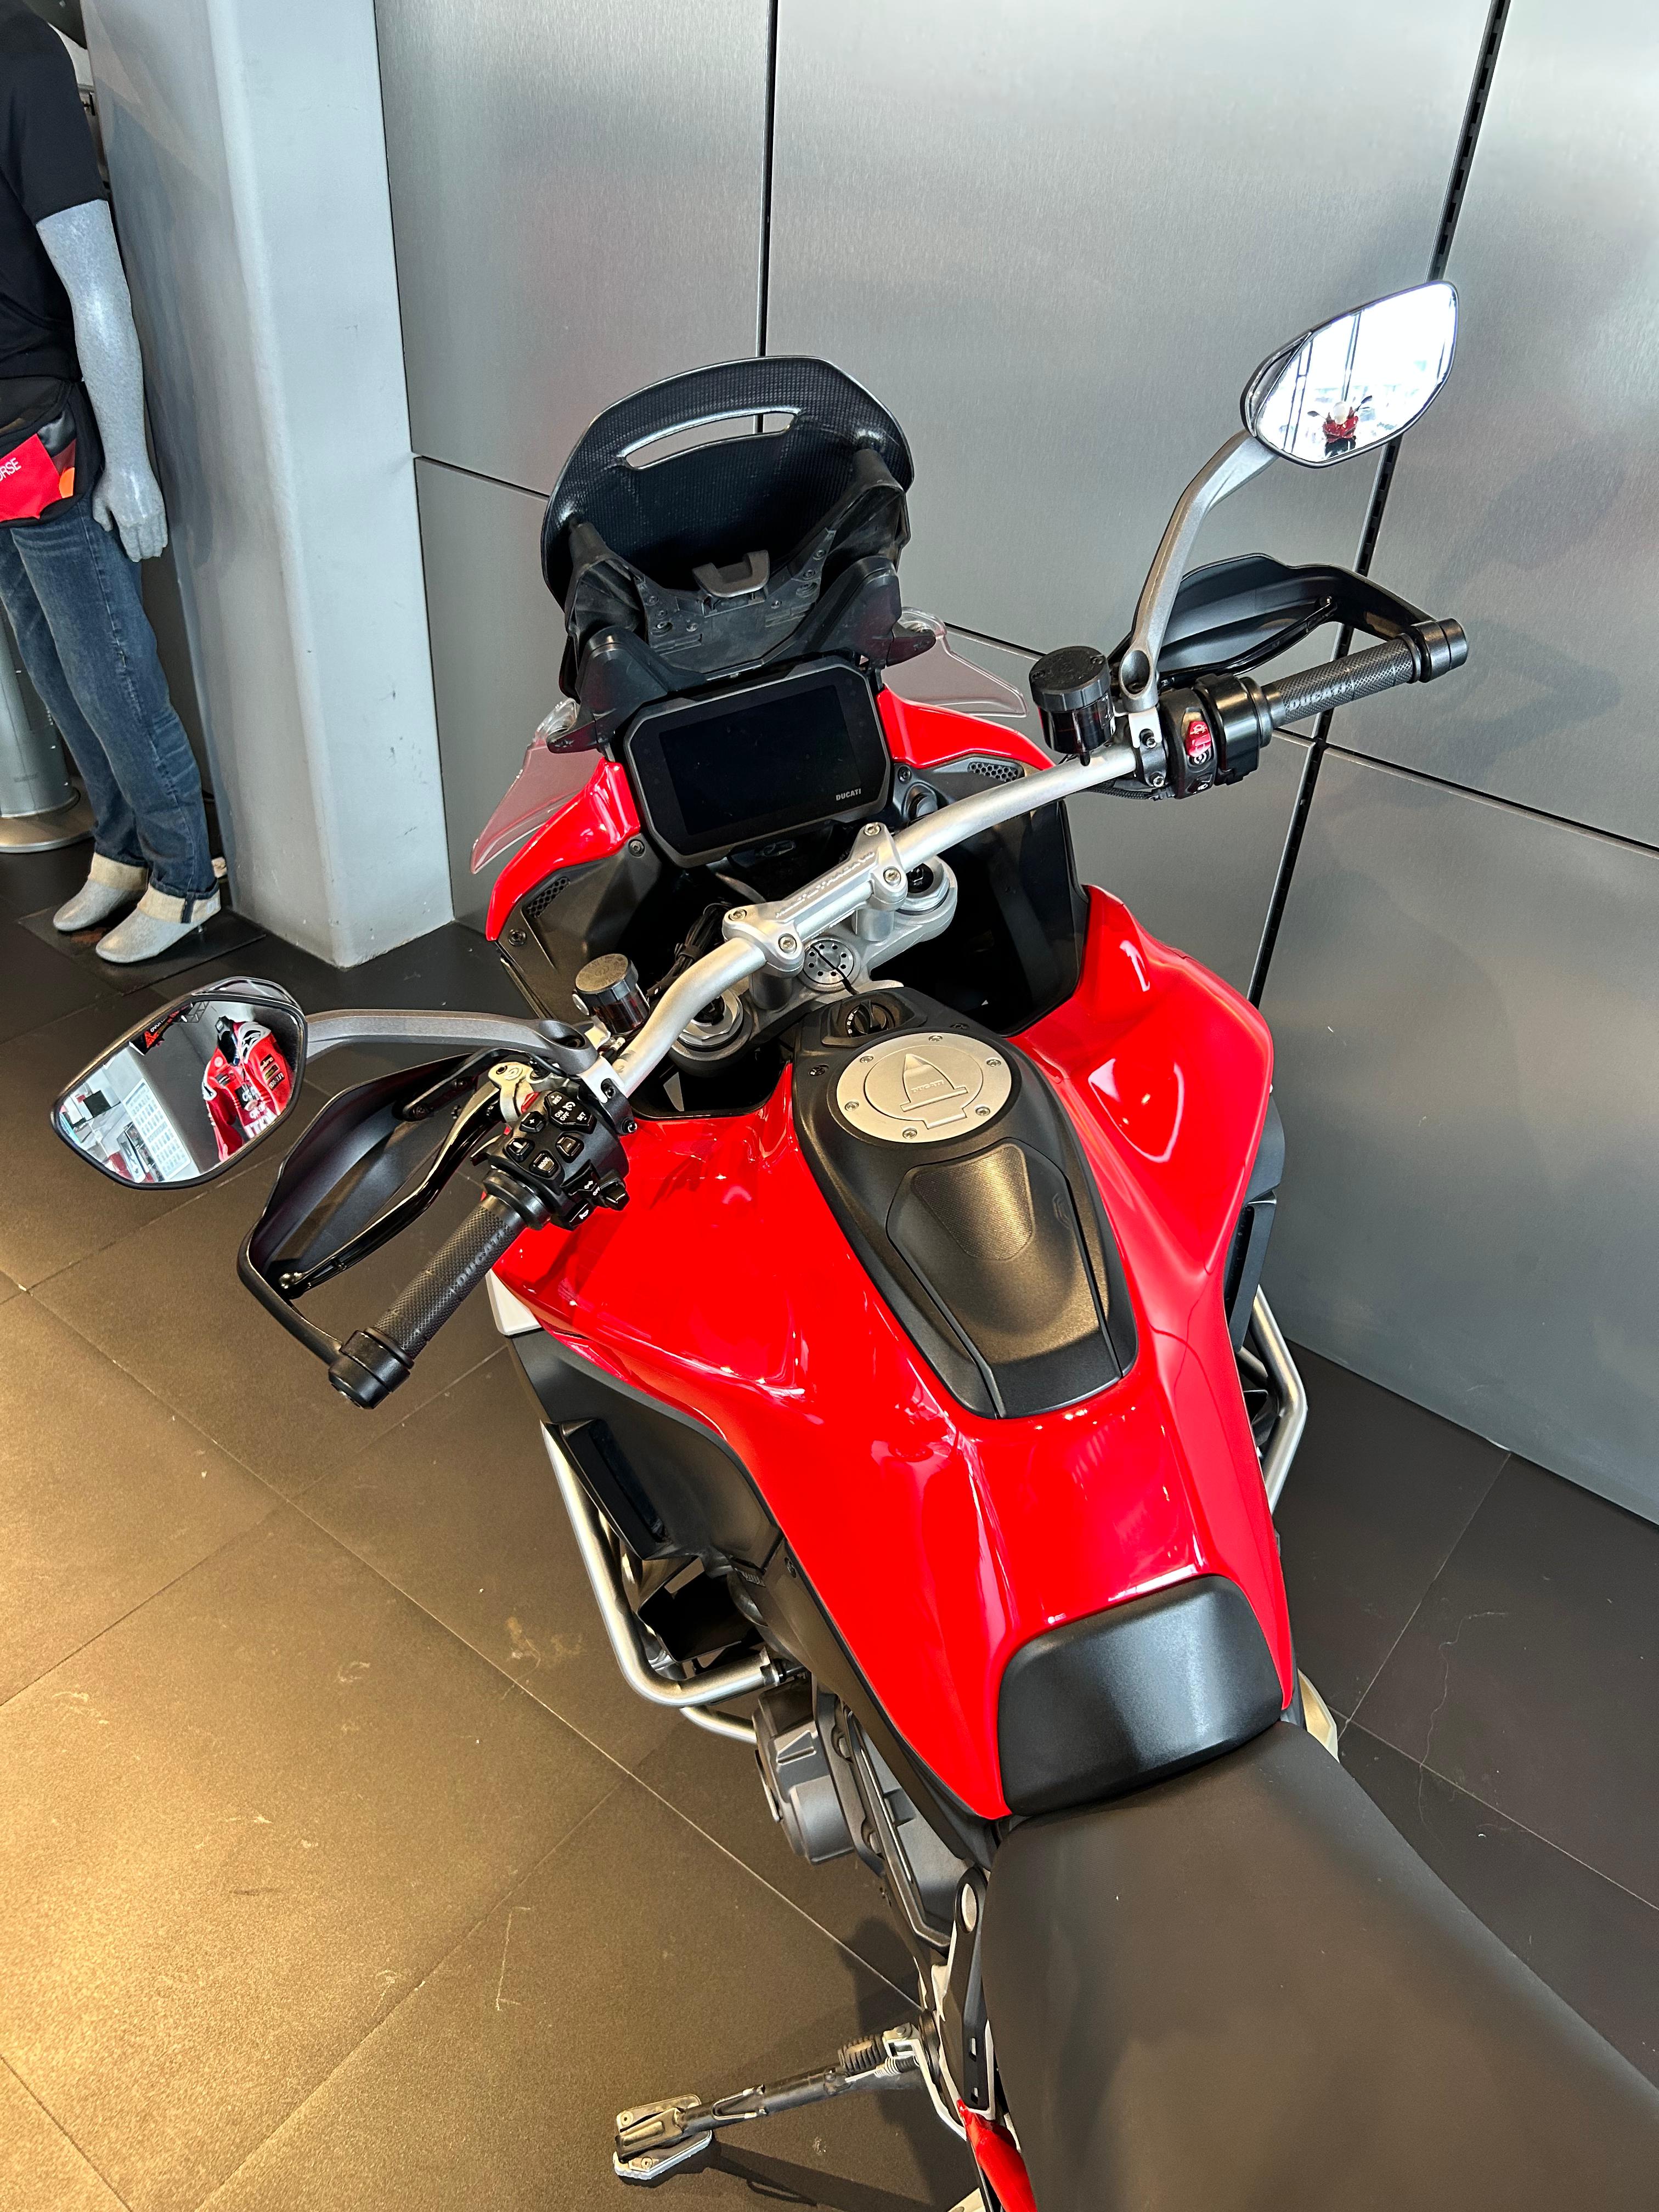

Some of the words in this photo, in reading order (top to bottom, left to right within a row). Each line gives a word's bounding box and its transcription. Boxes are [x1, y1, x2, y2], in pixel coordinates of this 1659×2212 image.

[836, 788, 861, 801] DUCATI
[554, 1109, 564, 1118] ON
[560, 1111, 569, 1121] OFF
[456, 1229, 505, 1286] DUCATI
